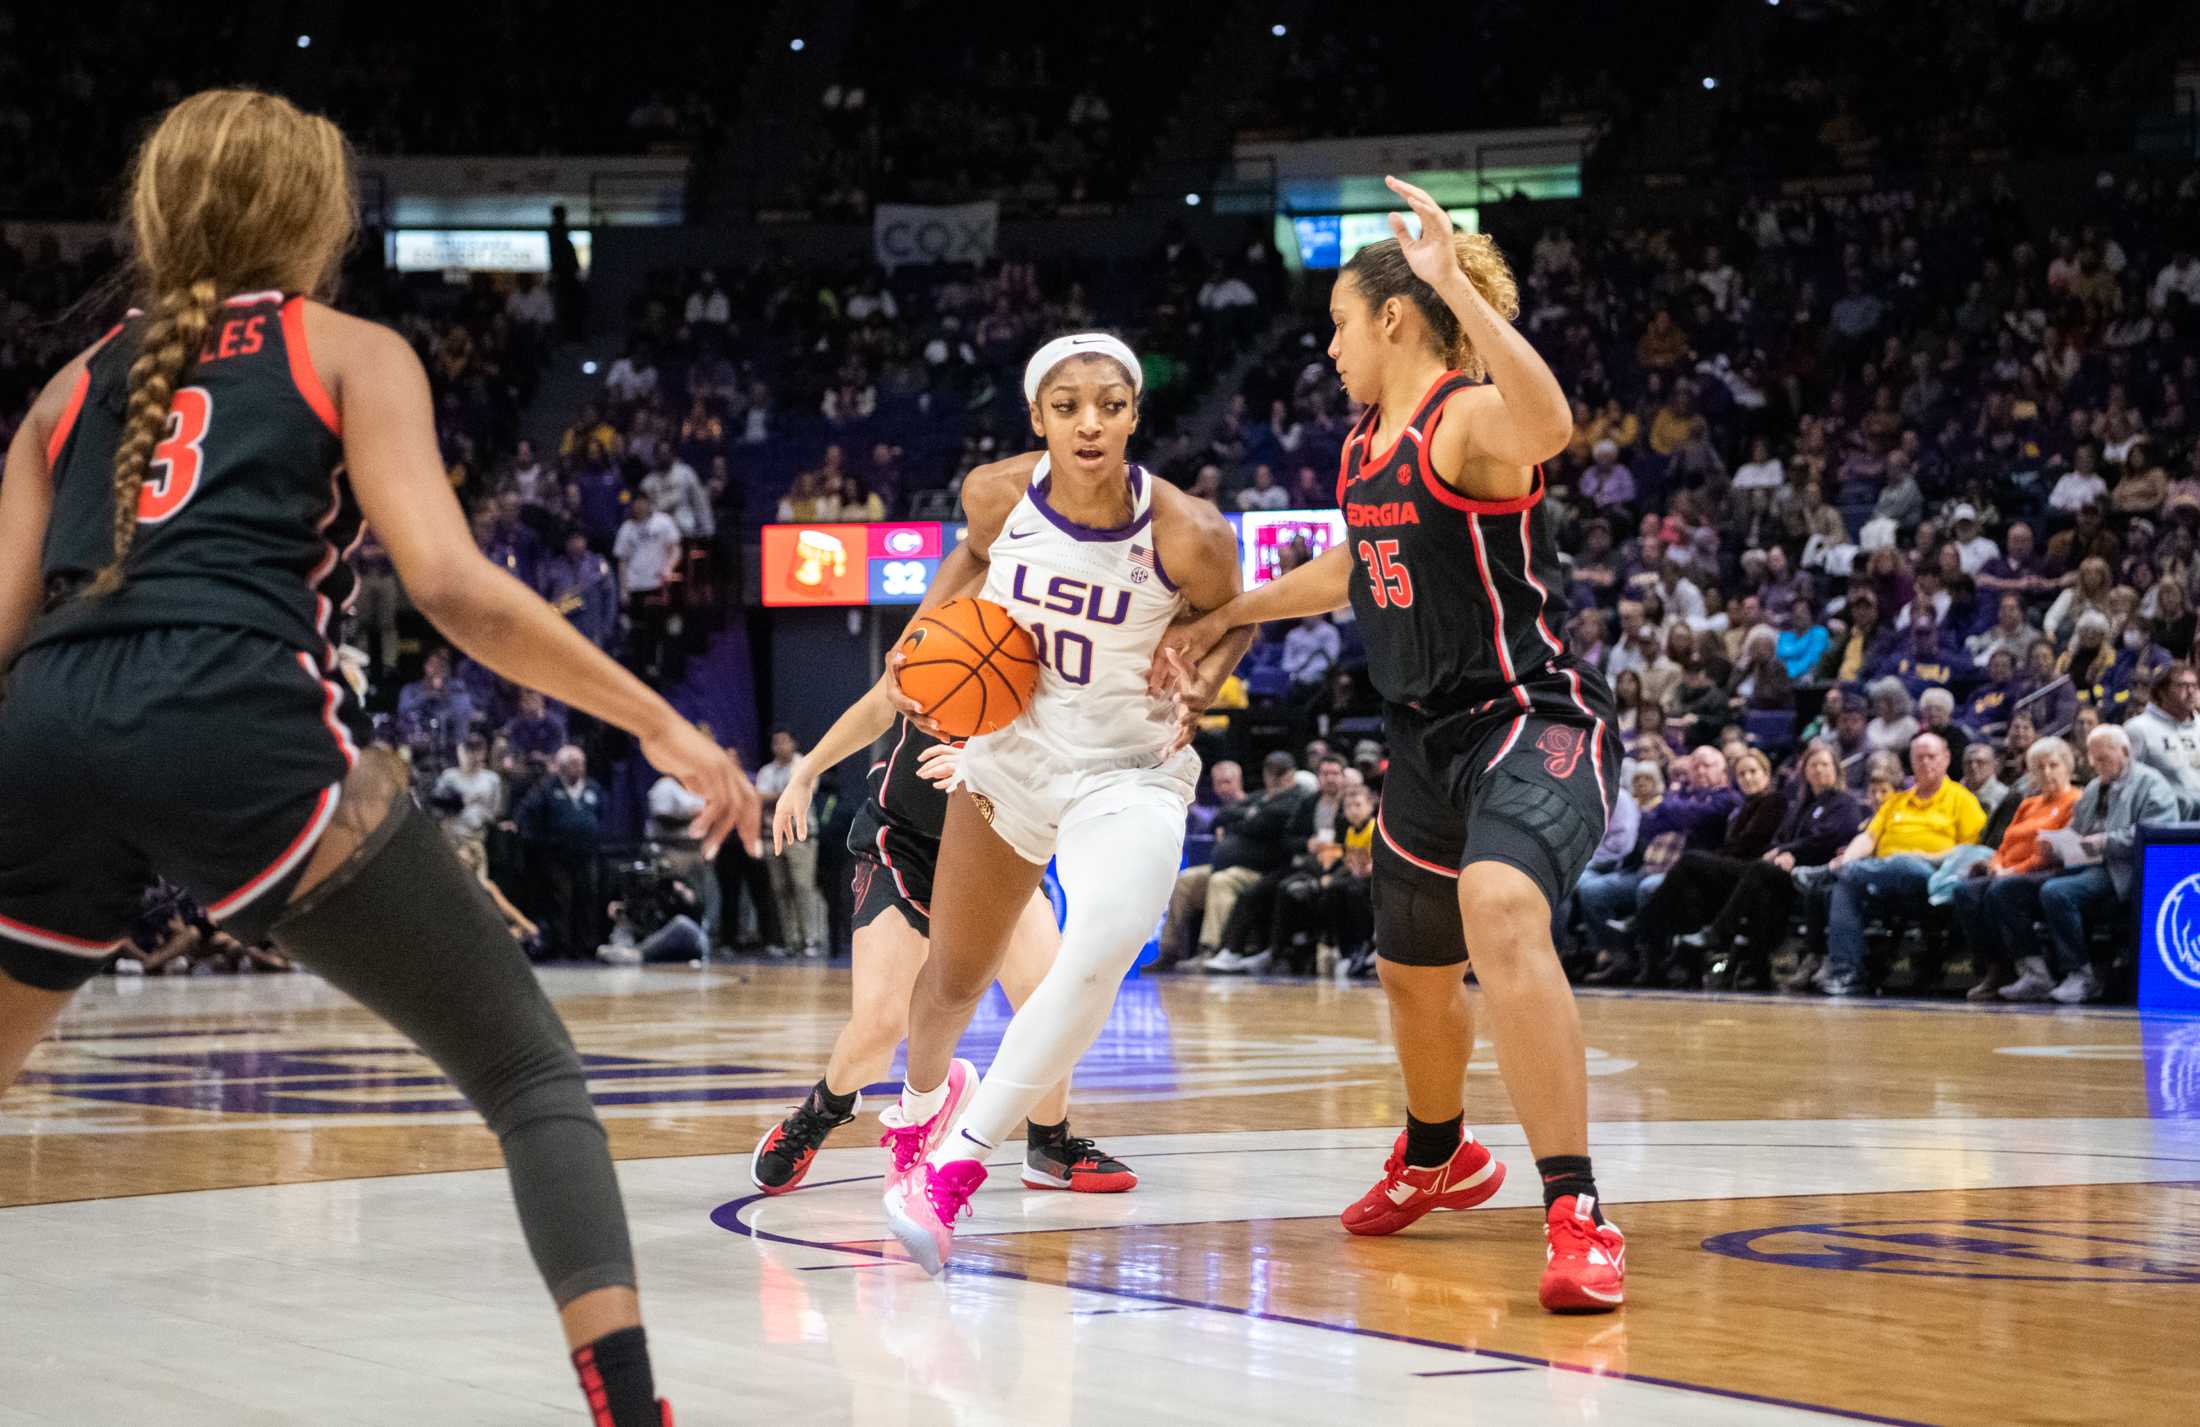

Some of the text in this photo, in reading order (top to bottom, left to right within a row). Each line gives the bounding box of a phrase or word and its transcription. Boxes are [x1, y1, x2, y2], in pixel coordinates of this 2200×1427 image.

[881, 220, 992, 256] COX
[137, 386, 213, 523] 3
[883, 561, 927, 595] 32
[1012, 563, 1132, 625] LSU
[1358, 539, 1414, 608] 35
[1030, 622, 1093, 686] 10
